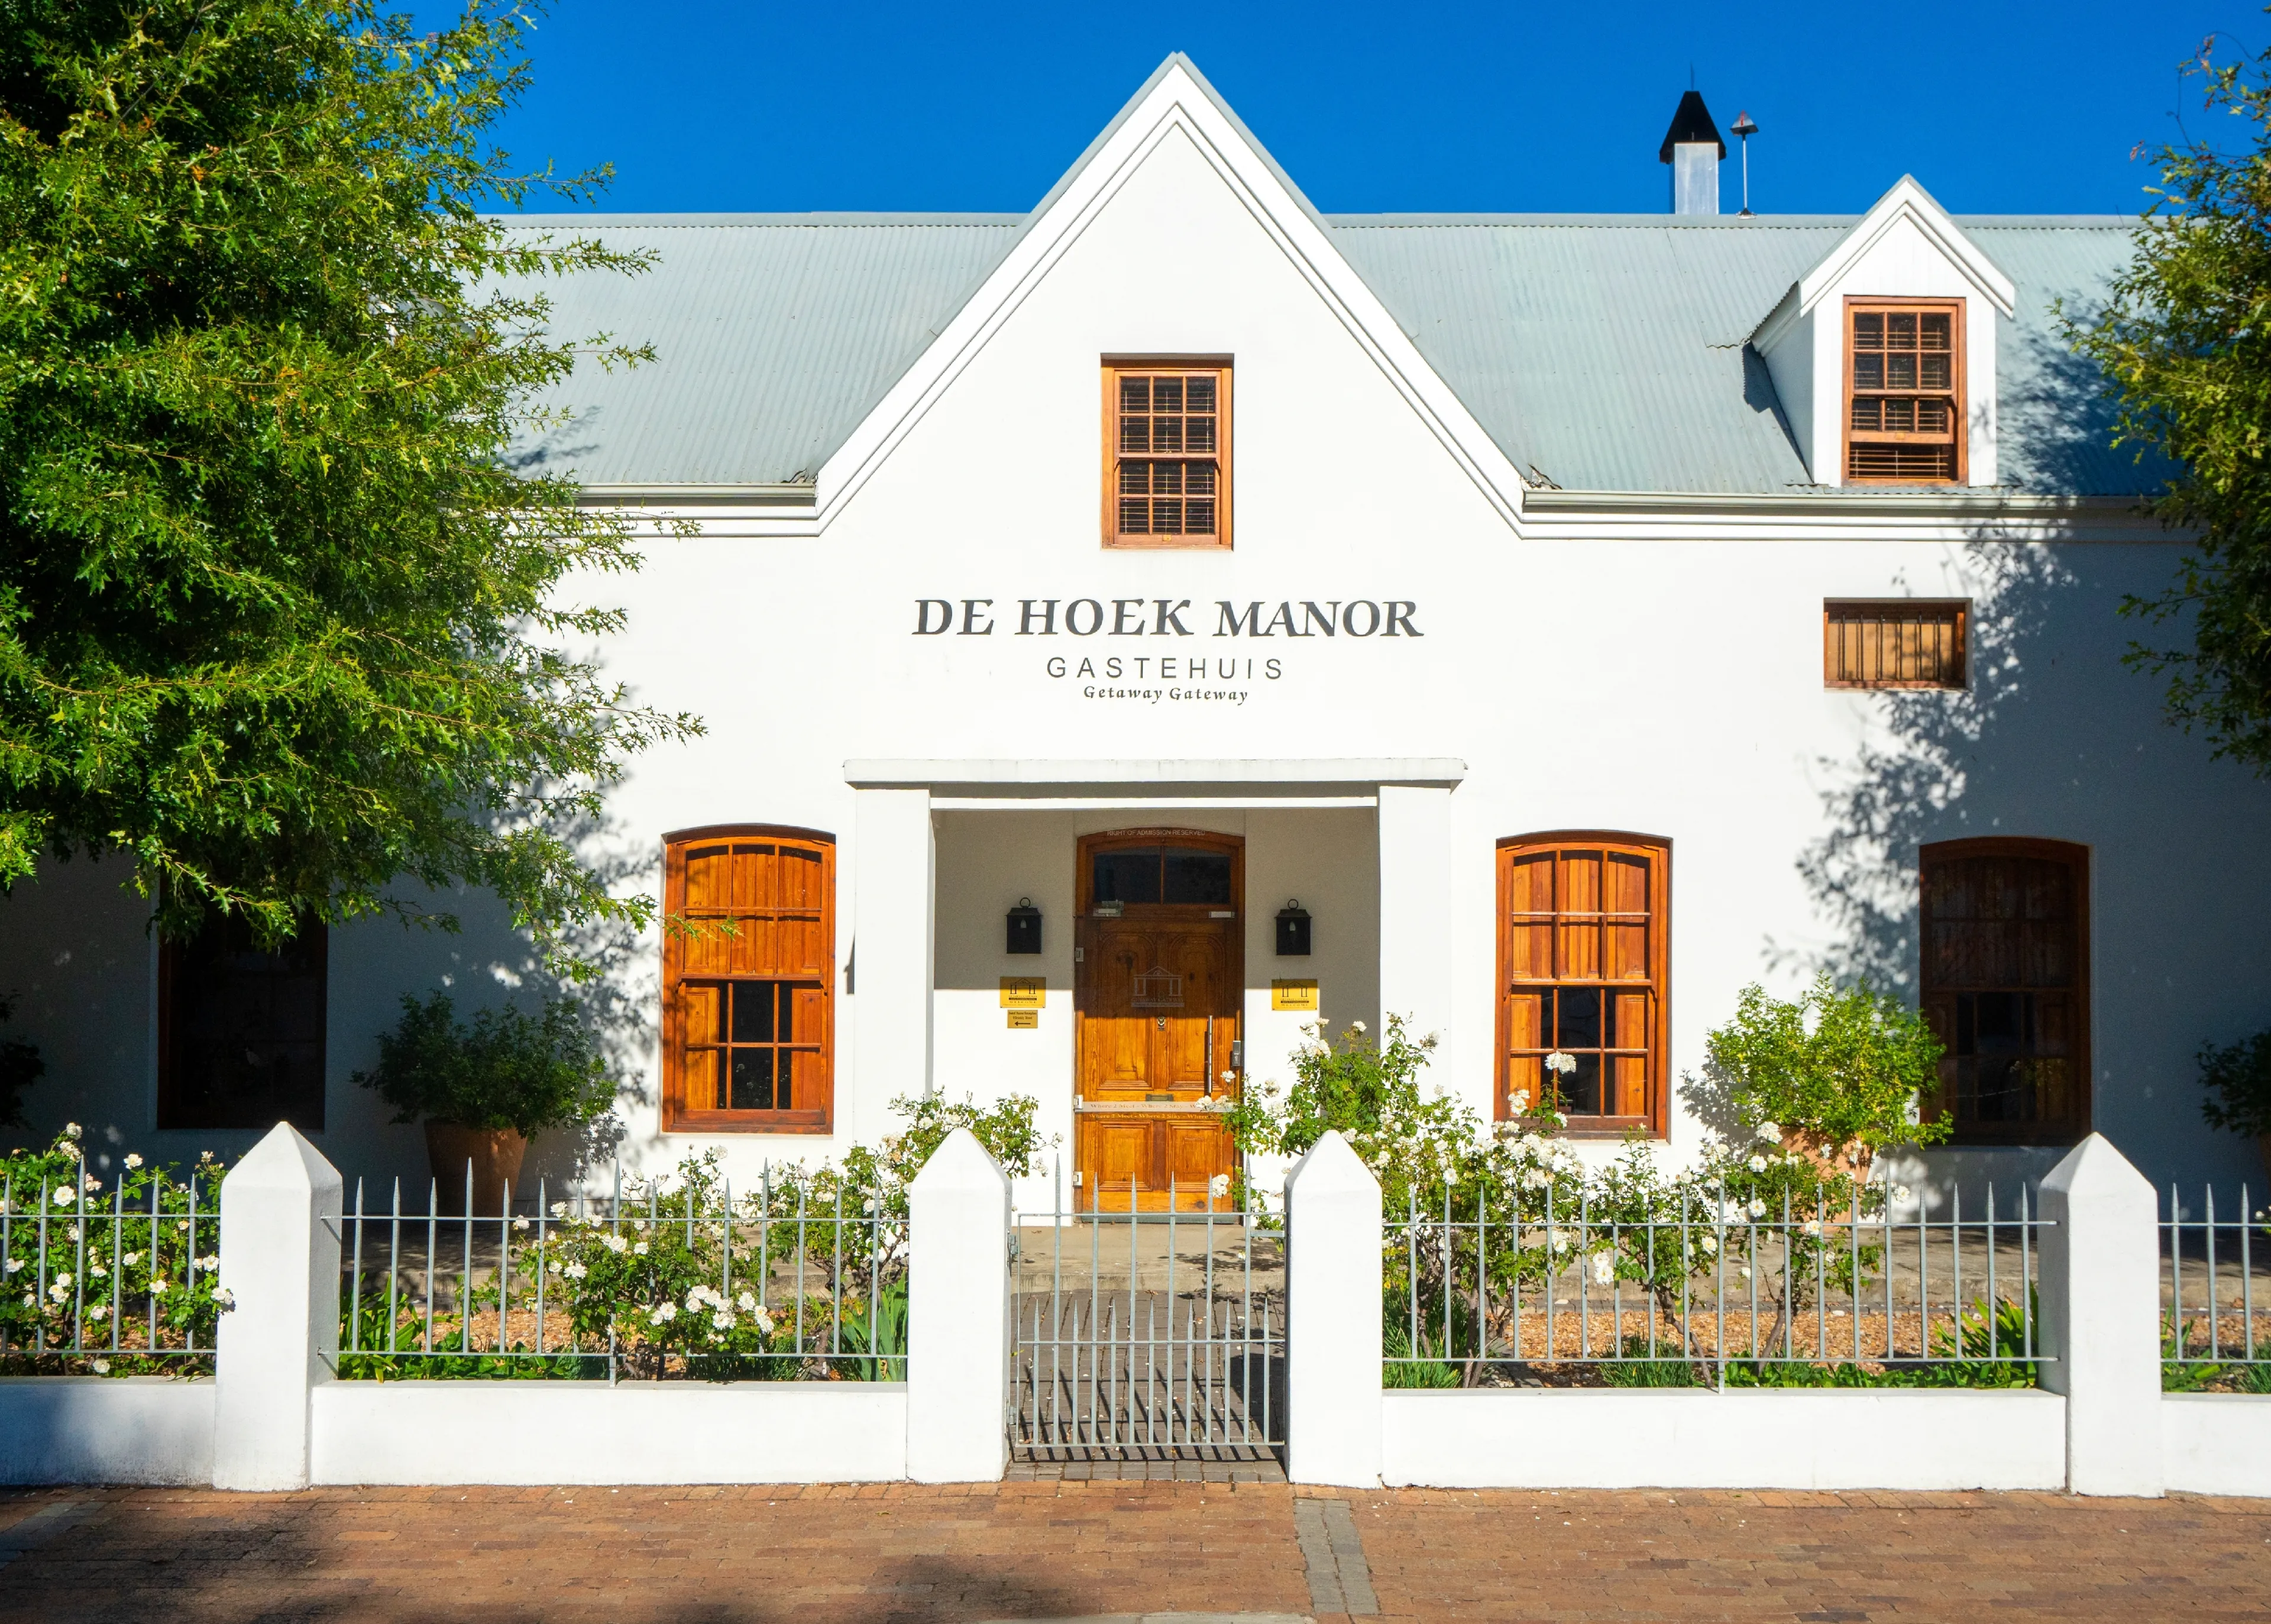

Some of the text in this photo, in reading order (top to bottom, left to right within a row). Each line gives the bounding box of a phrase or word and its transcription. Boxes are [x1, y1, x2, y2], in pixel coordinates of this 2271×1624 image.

[911, 598, 1425, 638] DE HOEK MANOR
[1047, 656, 1282, 680] GASTEHUIS
[1083, 685, 1248, 706] Getaway Gateway
